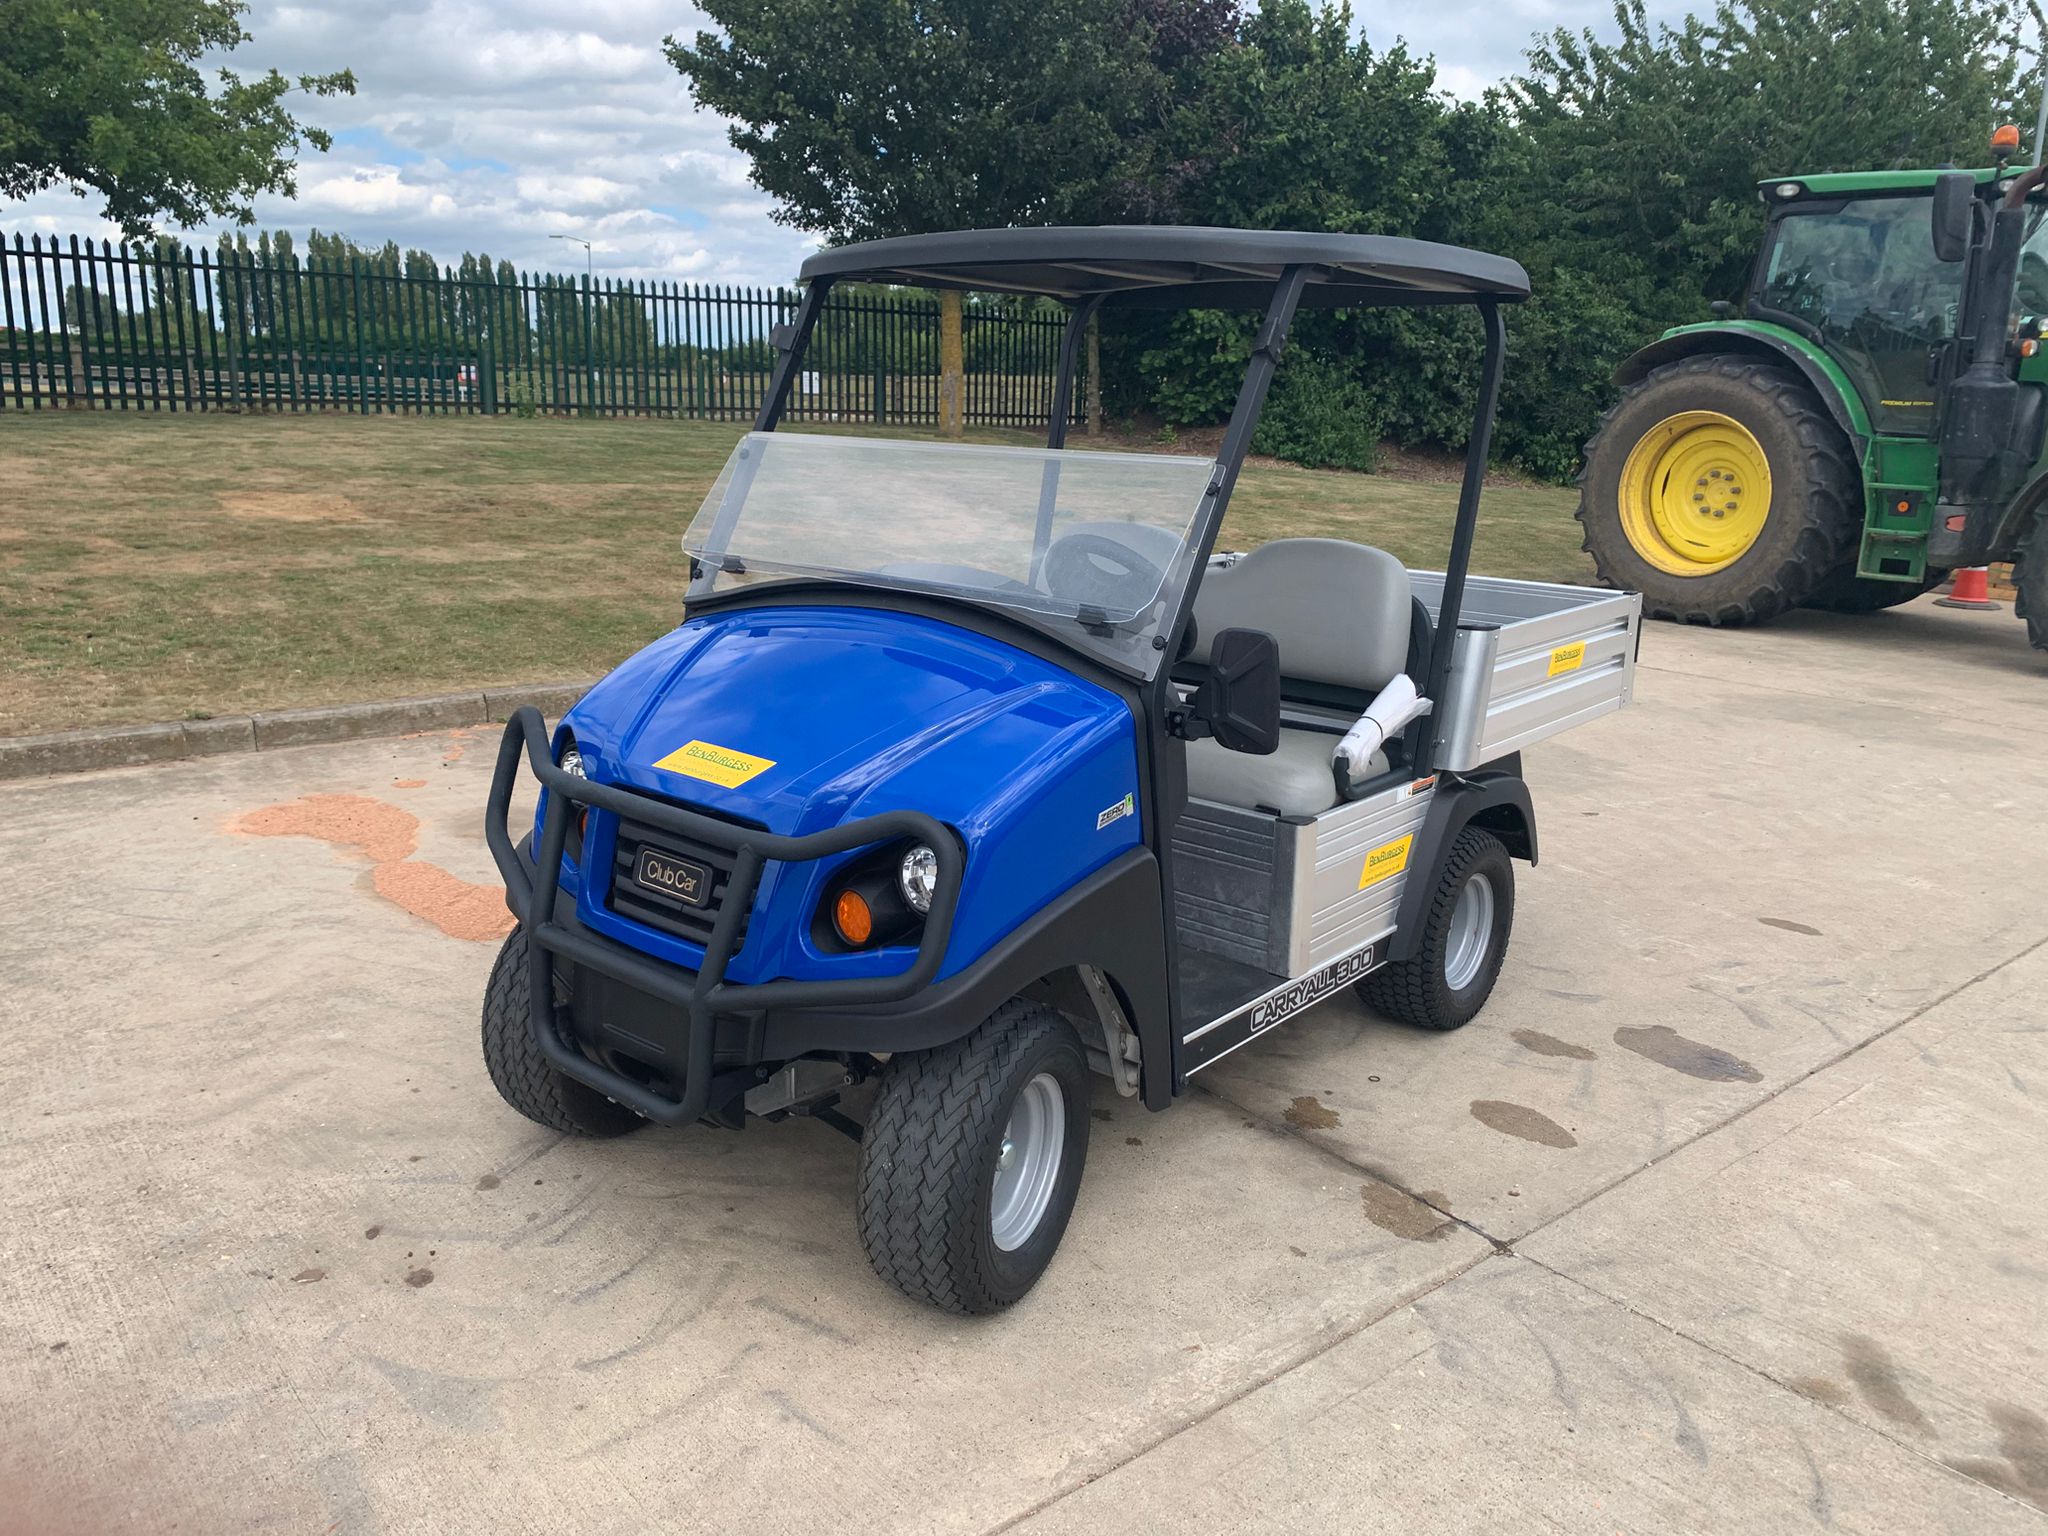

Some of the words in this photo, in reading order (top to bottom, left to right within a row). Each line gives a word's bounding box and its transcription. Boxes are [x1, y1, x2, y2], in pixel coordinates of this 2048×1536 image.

[1100, 802, 1125, 822] ZERO
[647, 860, 674, 884] Club
[675, 870, 697, 892] Car
[1251, 966, 1335, 1033] CARRYALL
[1336, 945, 1374, 984] 300
